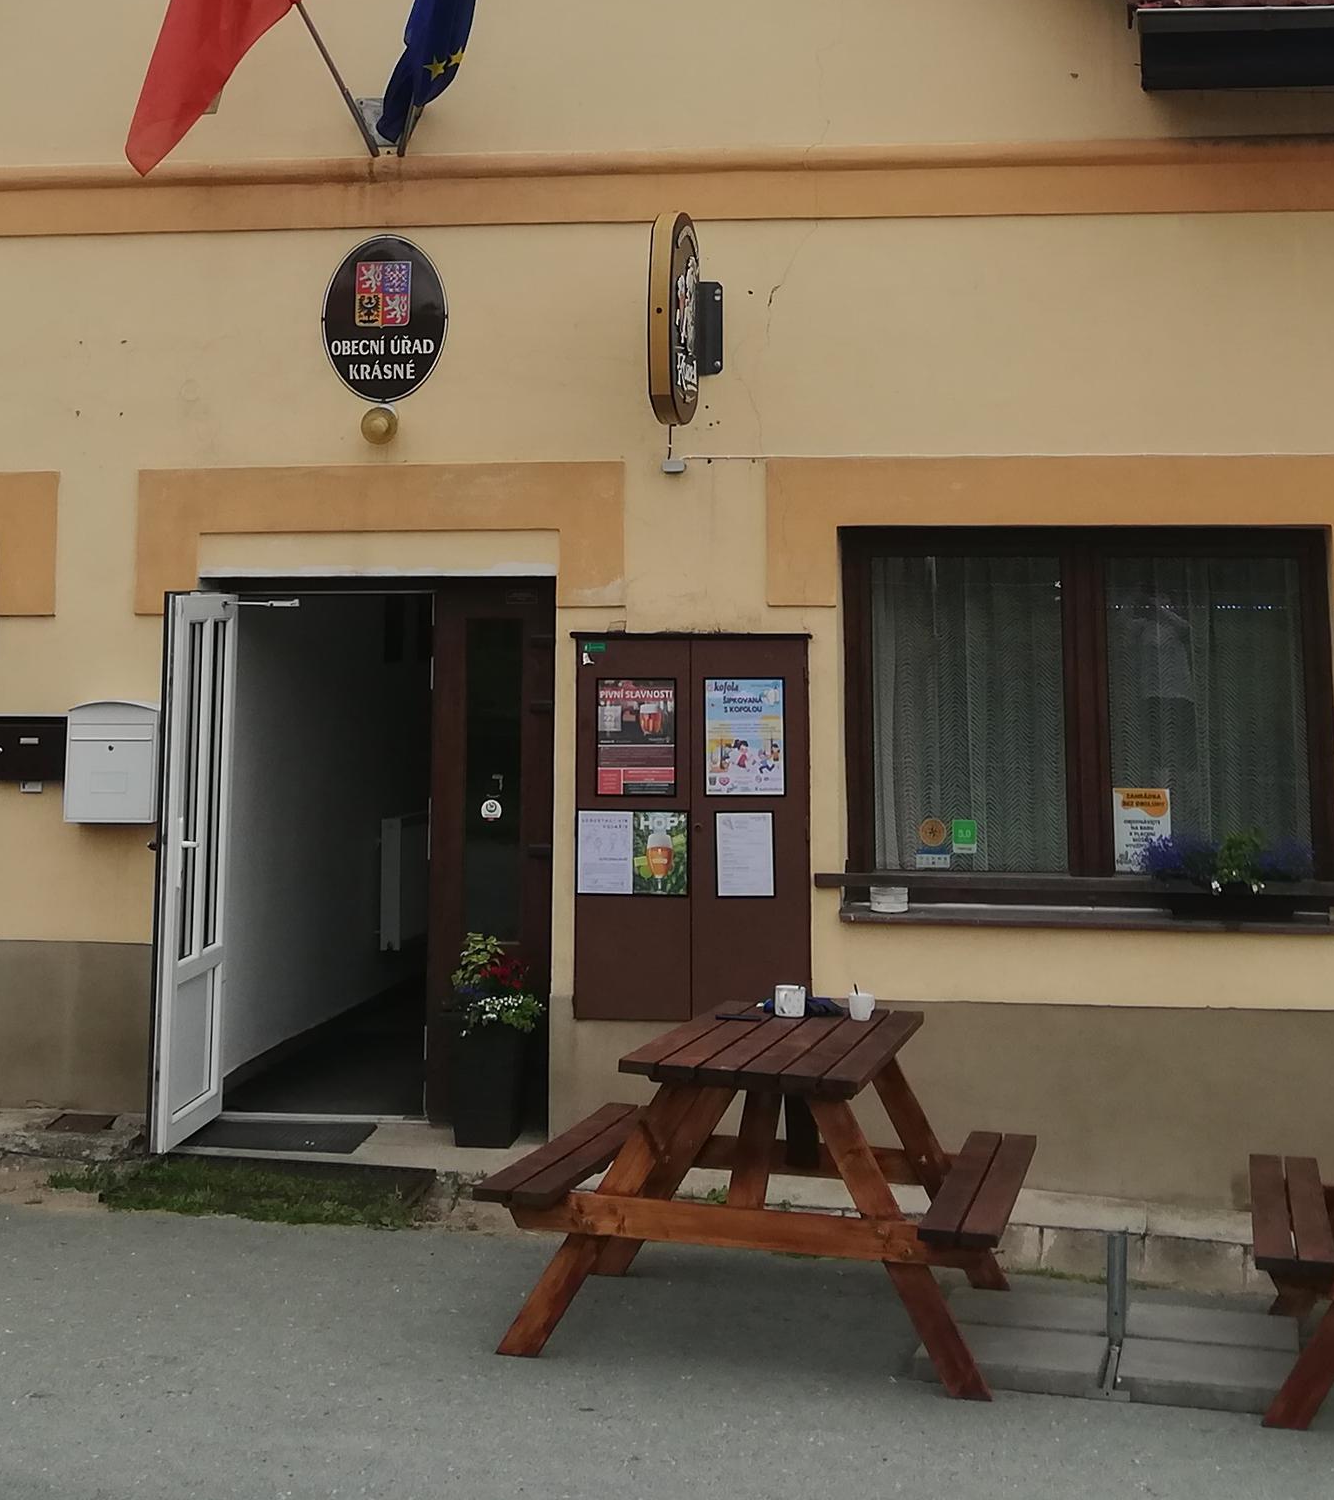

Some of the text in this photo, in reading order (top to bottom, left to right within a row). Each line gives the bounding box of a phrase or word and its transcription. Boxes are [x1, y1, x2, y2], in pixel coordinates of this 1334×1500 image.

[330, 335, 435, 357] OBECNÍ ÚŘAD
[348, 359, 416, 381] KRÁSNÉ
[599, 689, 673, 699] PIVNÍ SLAVNOSTI
[714, 681, 739, 694] kofola
